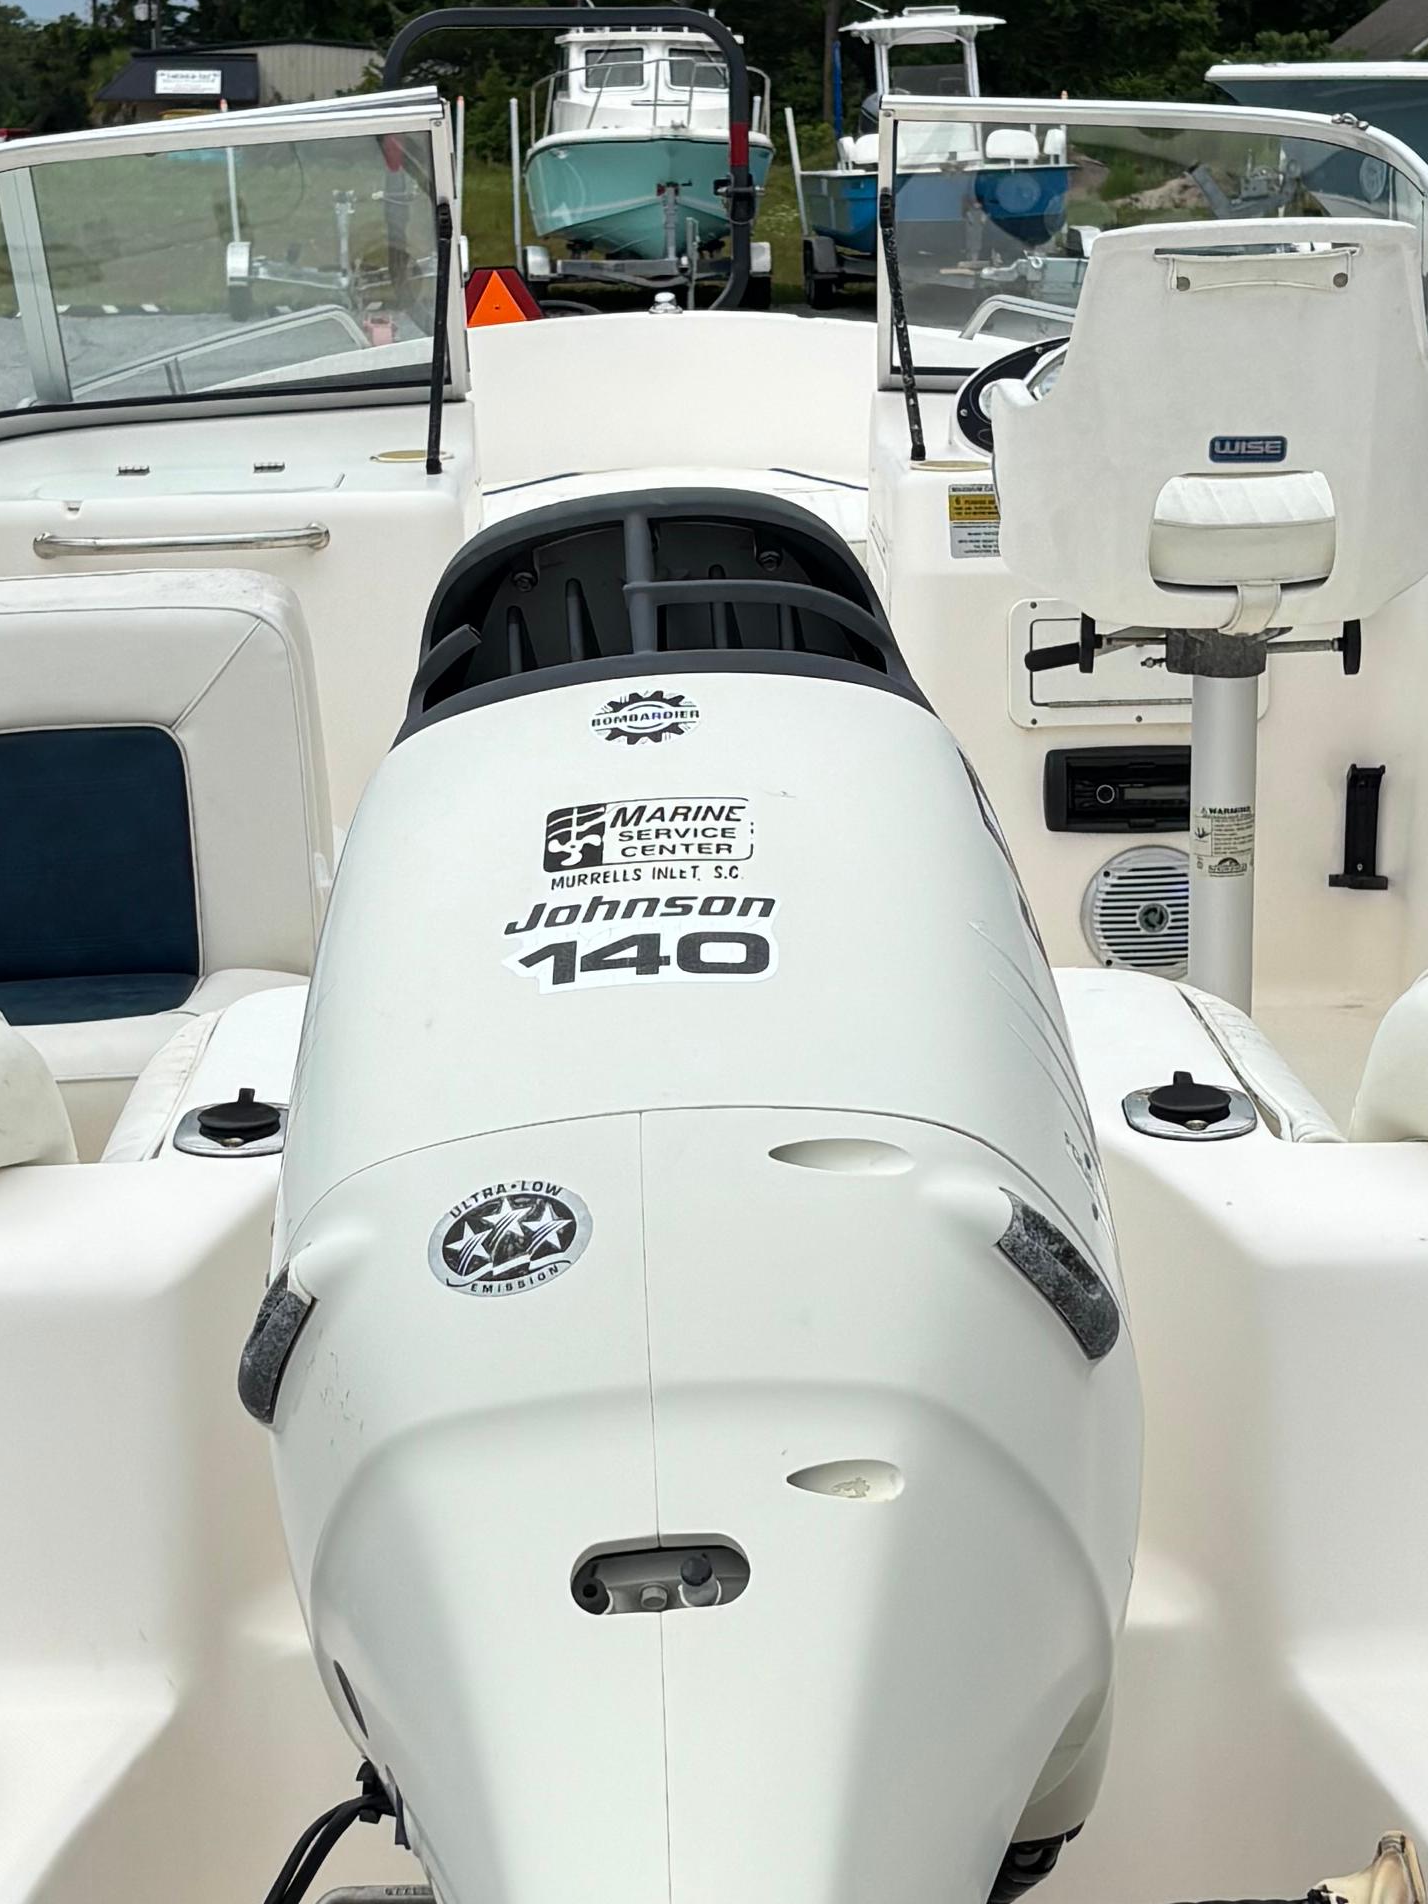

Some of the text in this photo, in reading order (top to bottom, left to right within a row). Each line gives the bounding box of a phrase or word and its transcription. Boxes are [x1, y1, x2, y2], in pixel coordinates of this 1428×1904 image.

[1214, 440, 1282, 454] WISE
[591, 709, 700, 727] BOMBARDIER
[609, 804, 747, 828] MARINE
[618, 827, 737, 842] SERVICE
[620, 843, 733, 858] CENTER
[551, 868, 642, 890] MURRELLS
[503, 895, 776, 935] Johnson
[518, 931, 771, 985] 140
[470, 1264, 560, 1294] EMISSION
